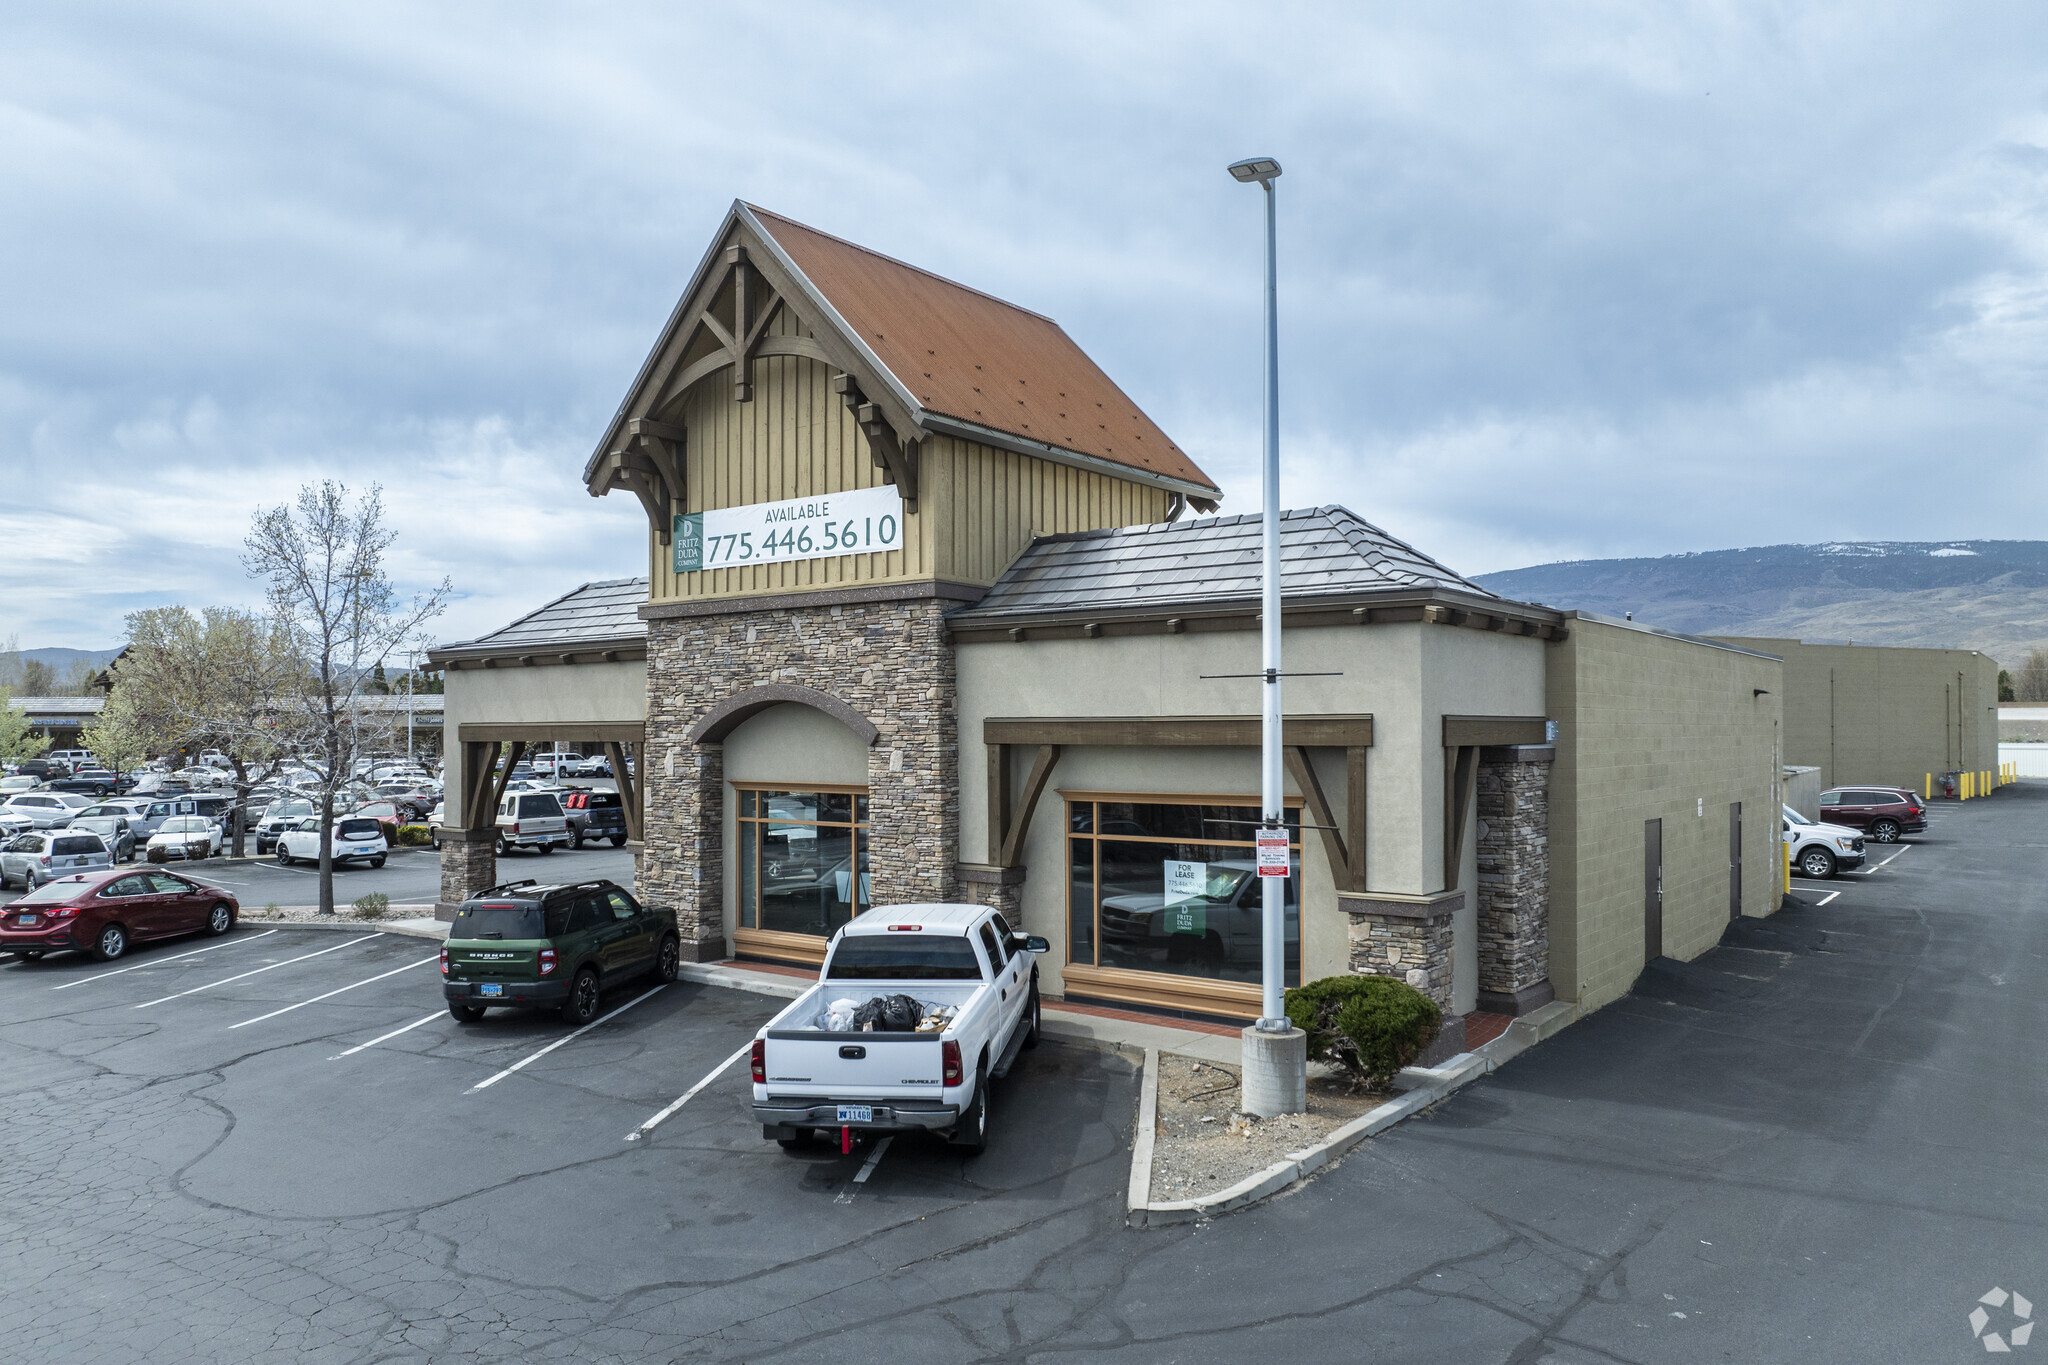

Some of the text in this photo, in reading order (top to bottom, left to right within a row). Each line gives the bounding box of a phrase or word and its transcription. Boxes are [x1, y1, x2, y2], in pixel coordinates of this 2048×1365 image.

[765, 501, 830, 524] AVAILABLE
[707, 514, 897, 563] 775.446.5610
[678, 538, 699, 549] FRITZ
[678, 548, 699, 559] DUDA
[678, 559, 699, 567] COMPANY
[1178, 864, 1192, 872] FOR
[1175, 871, 1195, 879] LEASE
[1176, 913, 1193, 921] FRITZ
